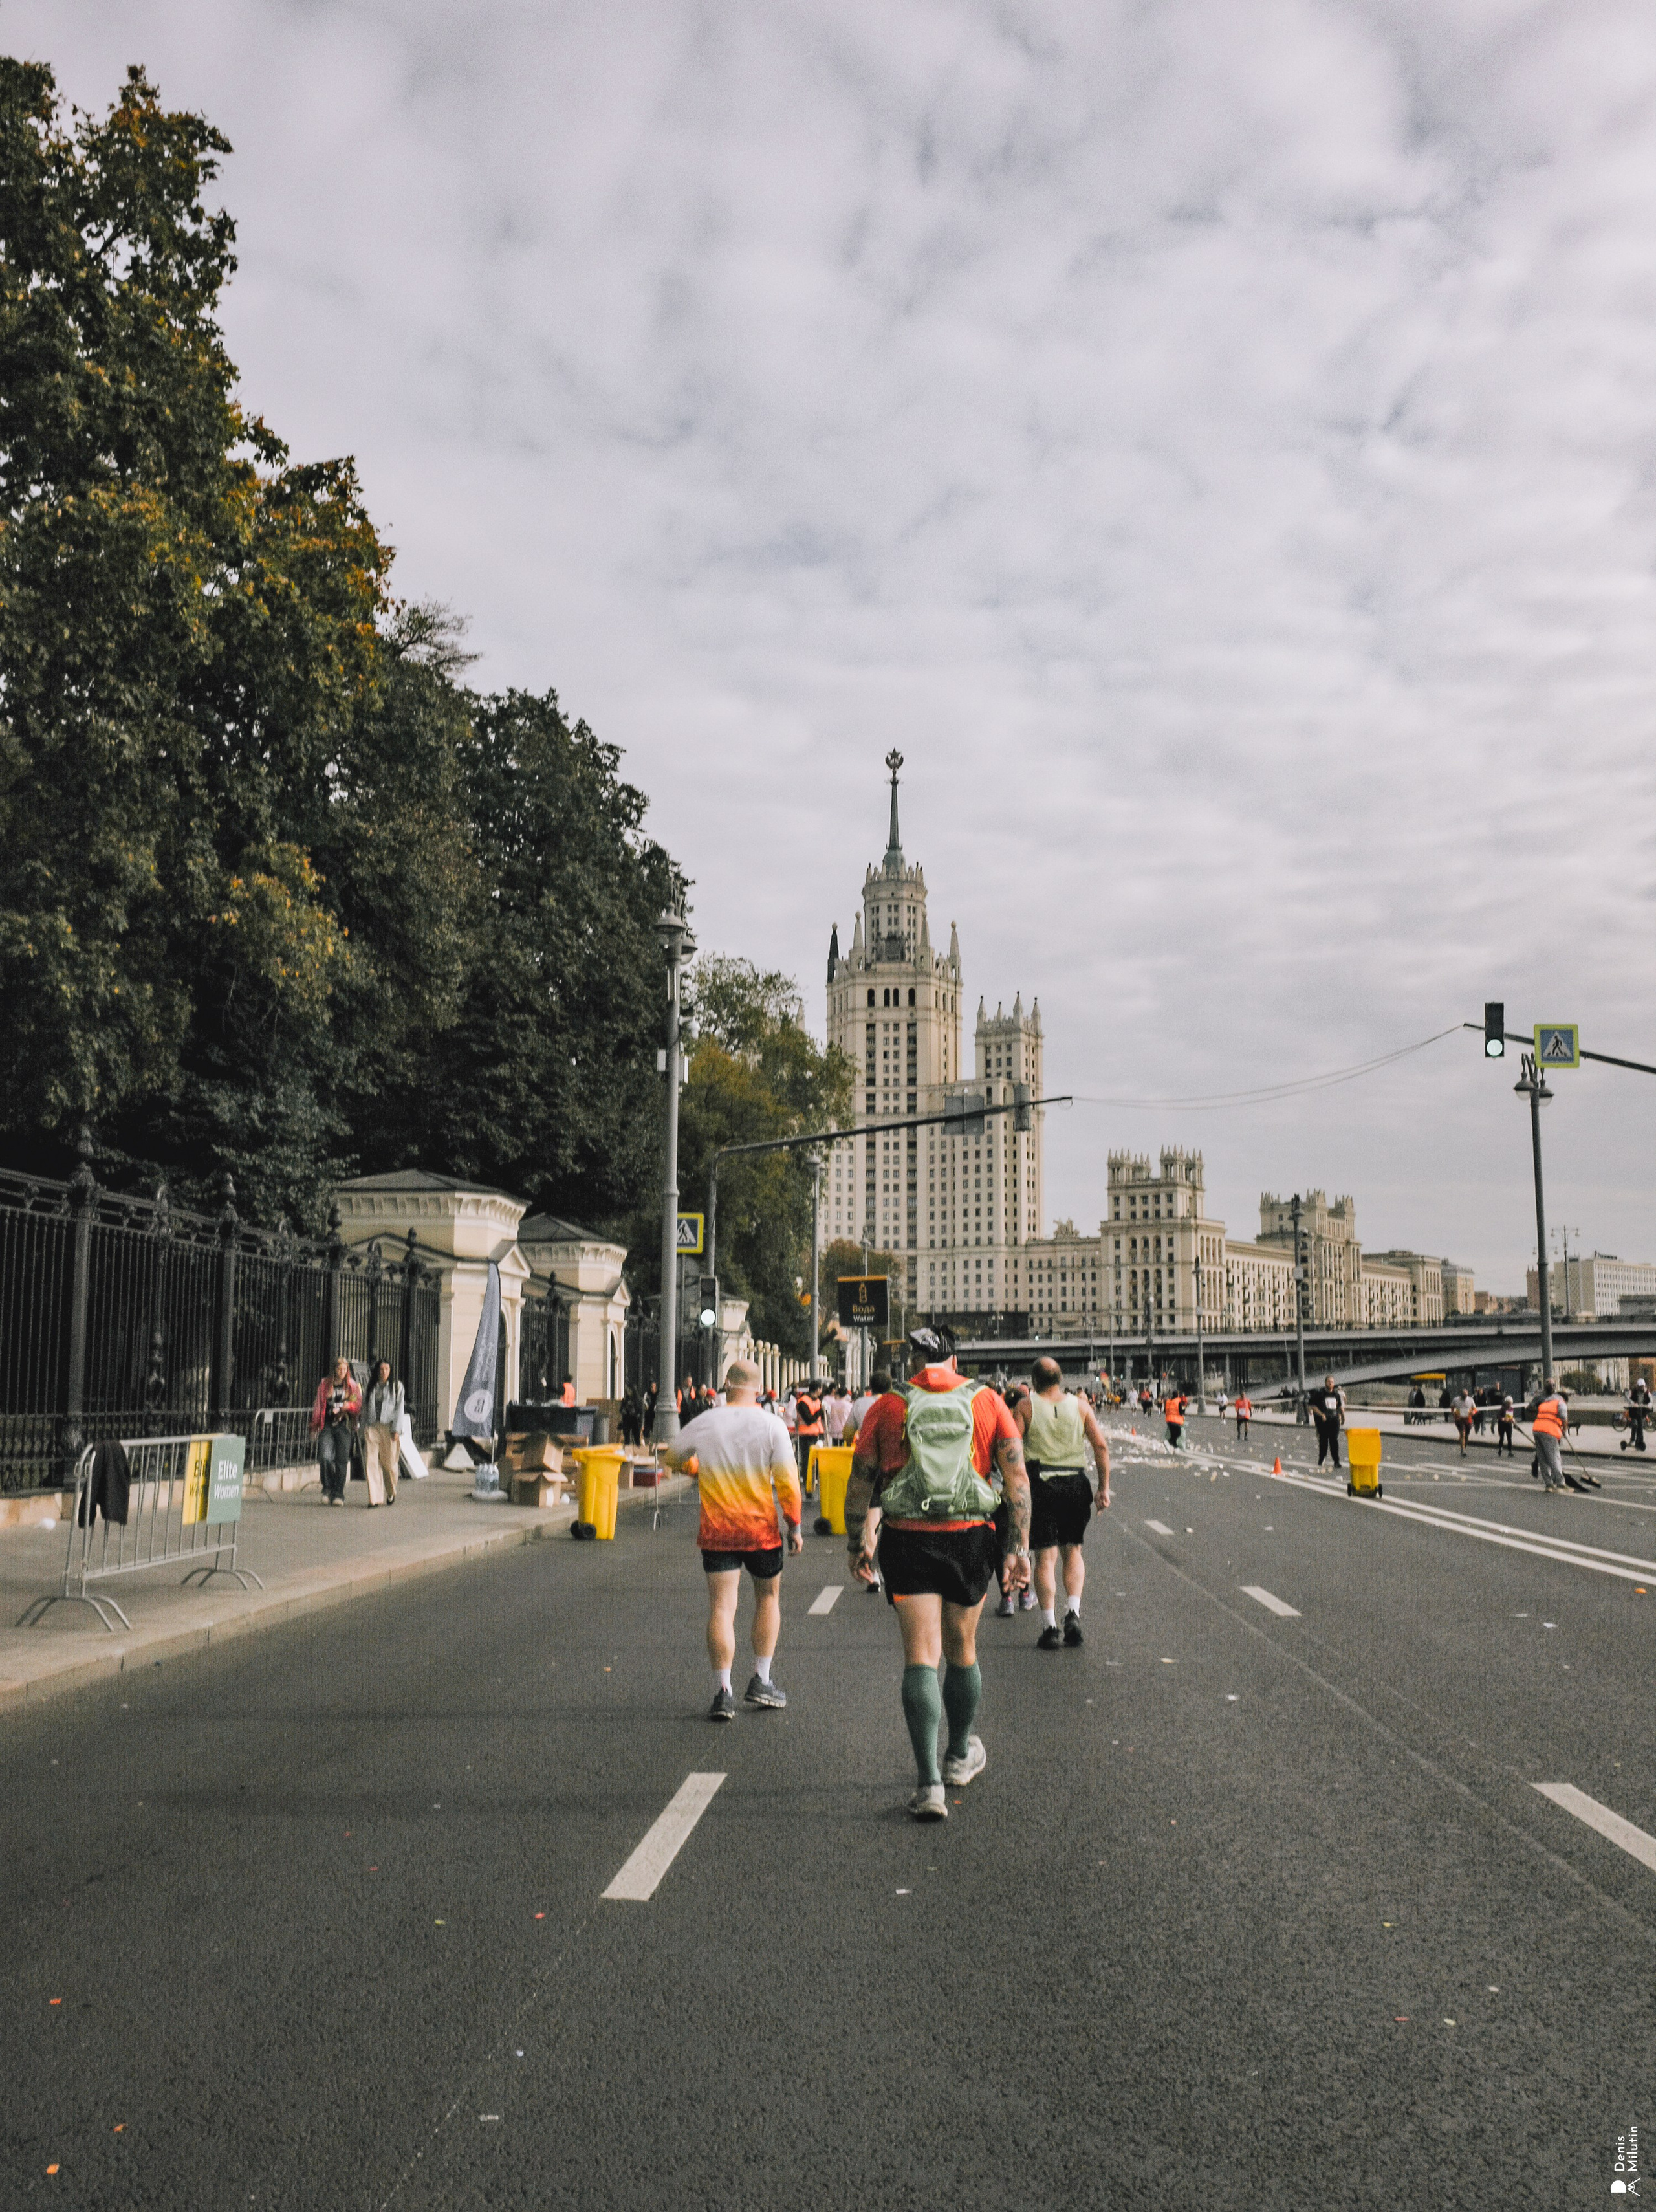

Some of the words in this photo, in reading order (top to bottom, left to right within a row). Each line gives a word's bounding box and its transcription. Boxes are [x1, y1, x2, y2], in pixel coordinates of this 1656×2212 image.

[852, 1303, 875, 1315] Вода
[217, 1460, 238, 1480] Elite
[214, 1484, 239, 1500] Women
